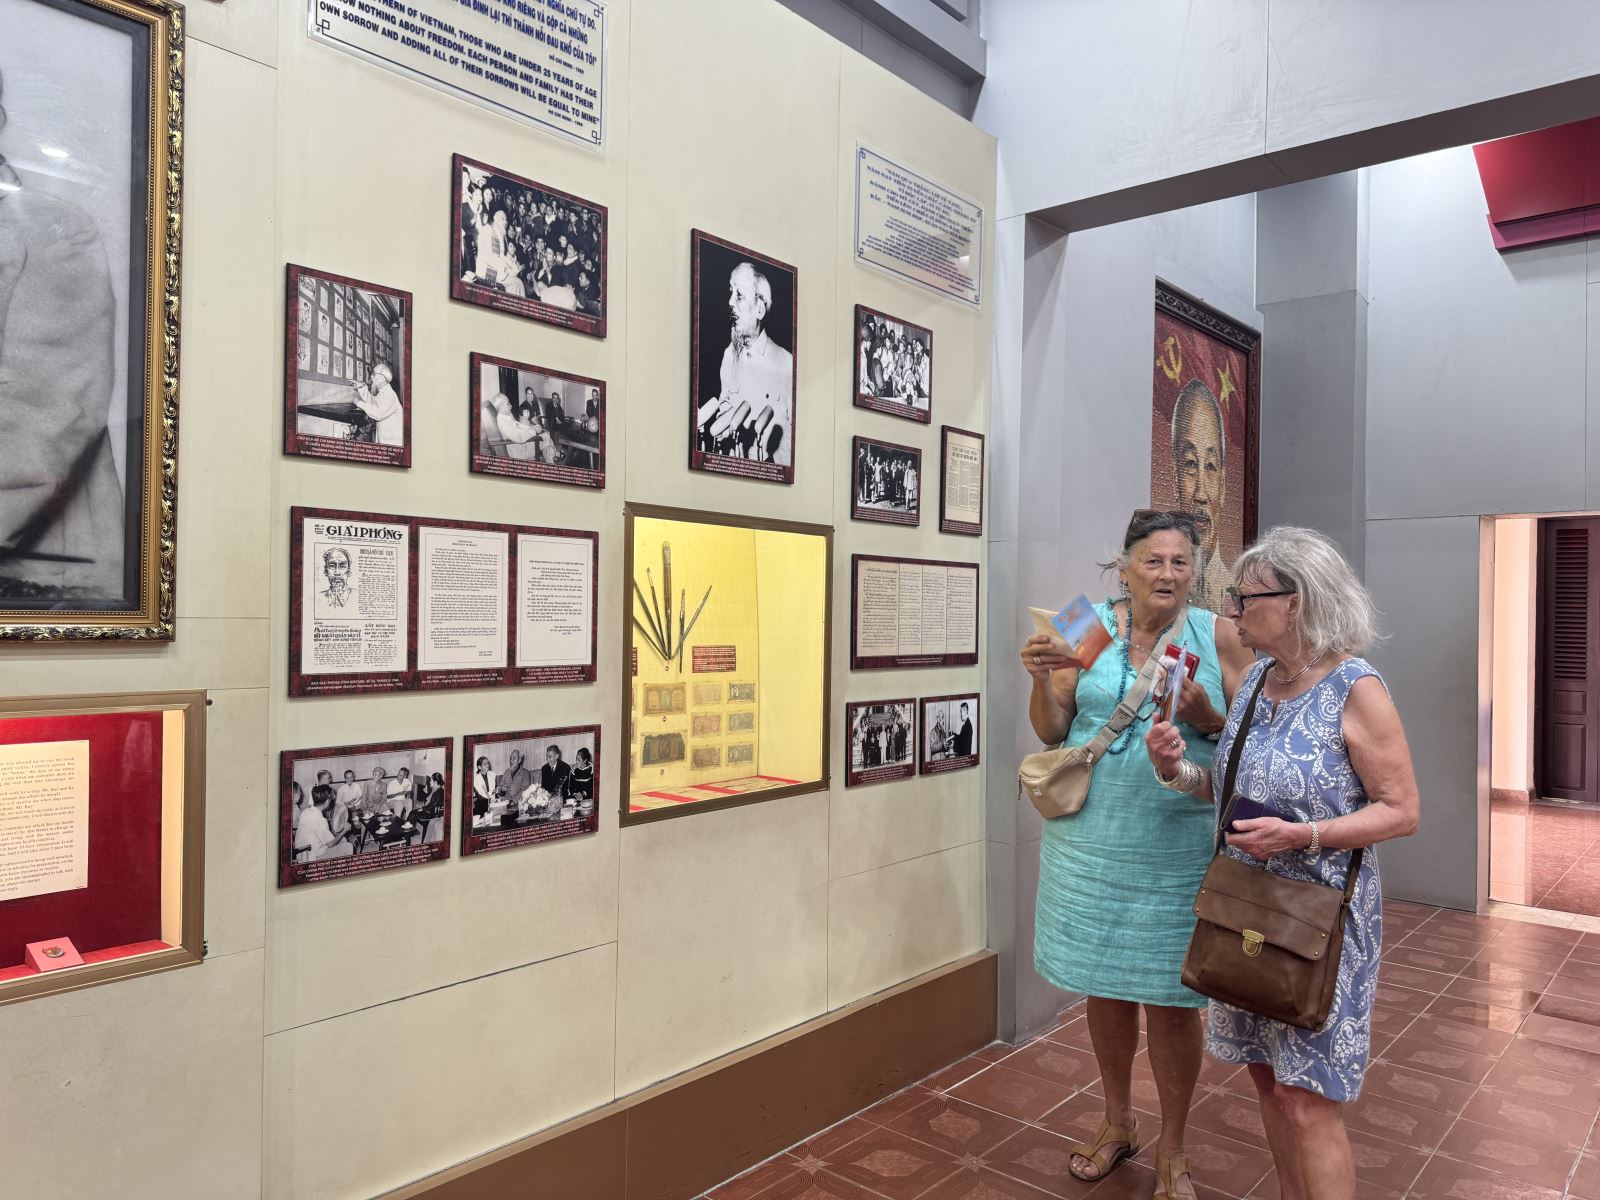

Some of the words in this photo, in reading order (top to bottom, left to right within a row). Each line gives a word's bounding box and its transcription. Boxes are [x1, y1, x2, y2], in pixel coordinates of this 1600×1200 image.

[319, 1, 340, 17] OWN
[342, 9, 379, 34] SORROW
[380, 25, 398, 42] AND
[400, 33, 430, 55] ADDING
[432, 47, 447, 62] ALL
[448, 54, 459, 67] OF
[460, 59, 483, 77] THEIR
[484, 69, 519, 92] SORROWS
[519, 85, 536, 99] WILL
[537, 92, 547, 104] BE
[548, 96, 570, 113] EQUAL
[571, 106, 580, 117] TO
[358, 0, 396, 25] NOTHING
[398, 17, 425, 38] ABOUT
[427, 30, 465, 55] FREEDOM.
[467, 47, 487, 64] EACH
[489, 56, 517, 77] PERSON
[518, 69, 533, 84] AND
[534, 77, 558, 95] FAMILY
[560, 87, 573, 101] HAS
[574, 94, 593, 110] THEIR
[406, 5, 417, 20] OF
[419, 11, 457, 37] VIETNAM,
[458, 28, 483, 48] THOSE
[484, 40, 501, 56] WHO
[502, 48, 517, 63] ARE
[518, 55, 541, 74] UNDER
[543, 66, 551, 78] 25
[552, 70, 573, 88] YEARS
[574, 80, 584, 93] OF
[584, 85, 597, 99] AGE
